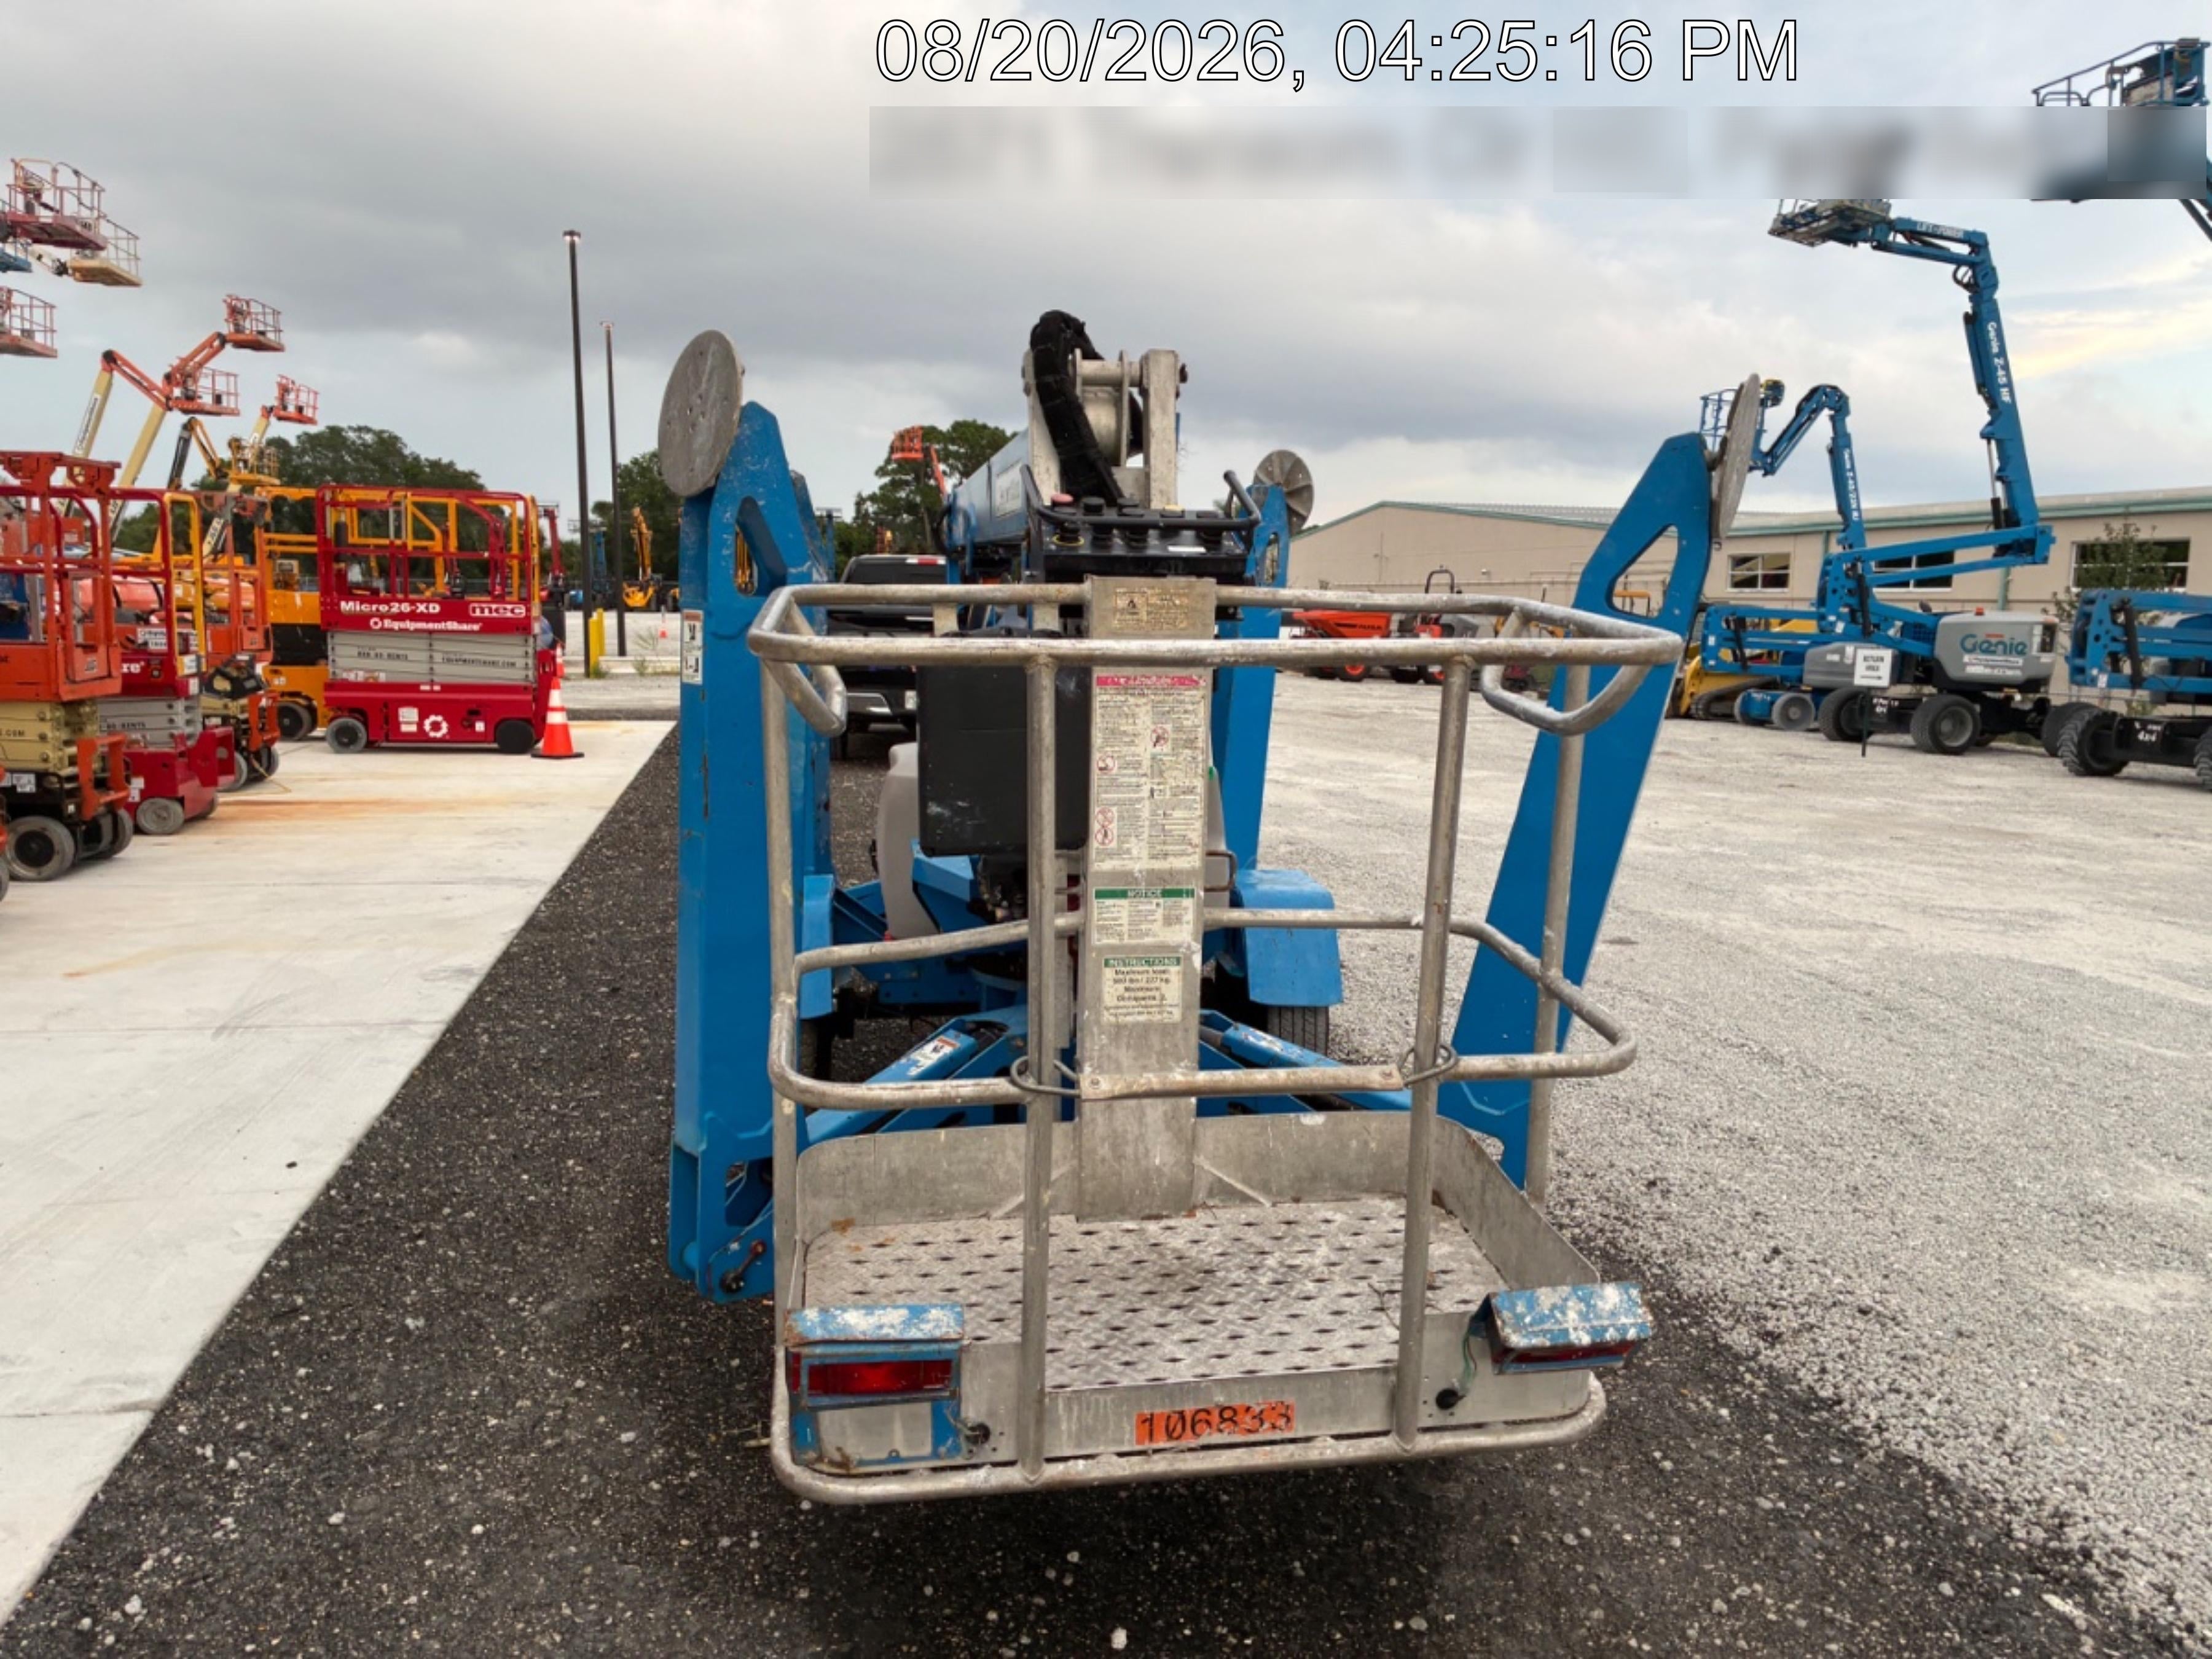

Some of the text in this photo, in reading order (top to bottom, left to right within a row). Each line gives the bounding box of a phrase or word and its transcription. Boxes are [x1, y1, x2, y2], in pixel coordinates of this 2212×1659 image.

[340, 600, 525, 616] Micro26-XD mec
[382, 618, 482, 632] EquipmentShare
[1960, 632, 2028, 656] Genie
